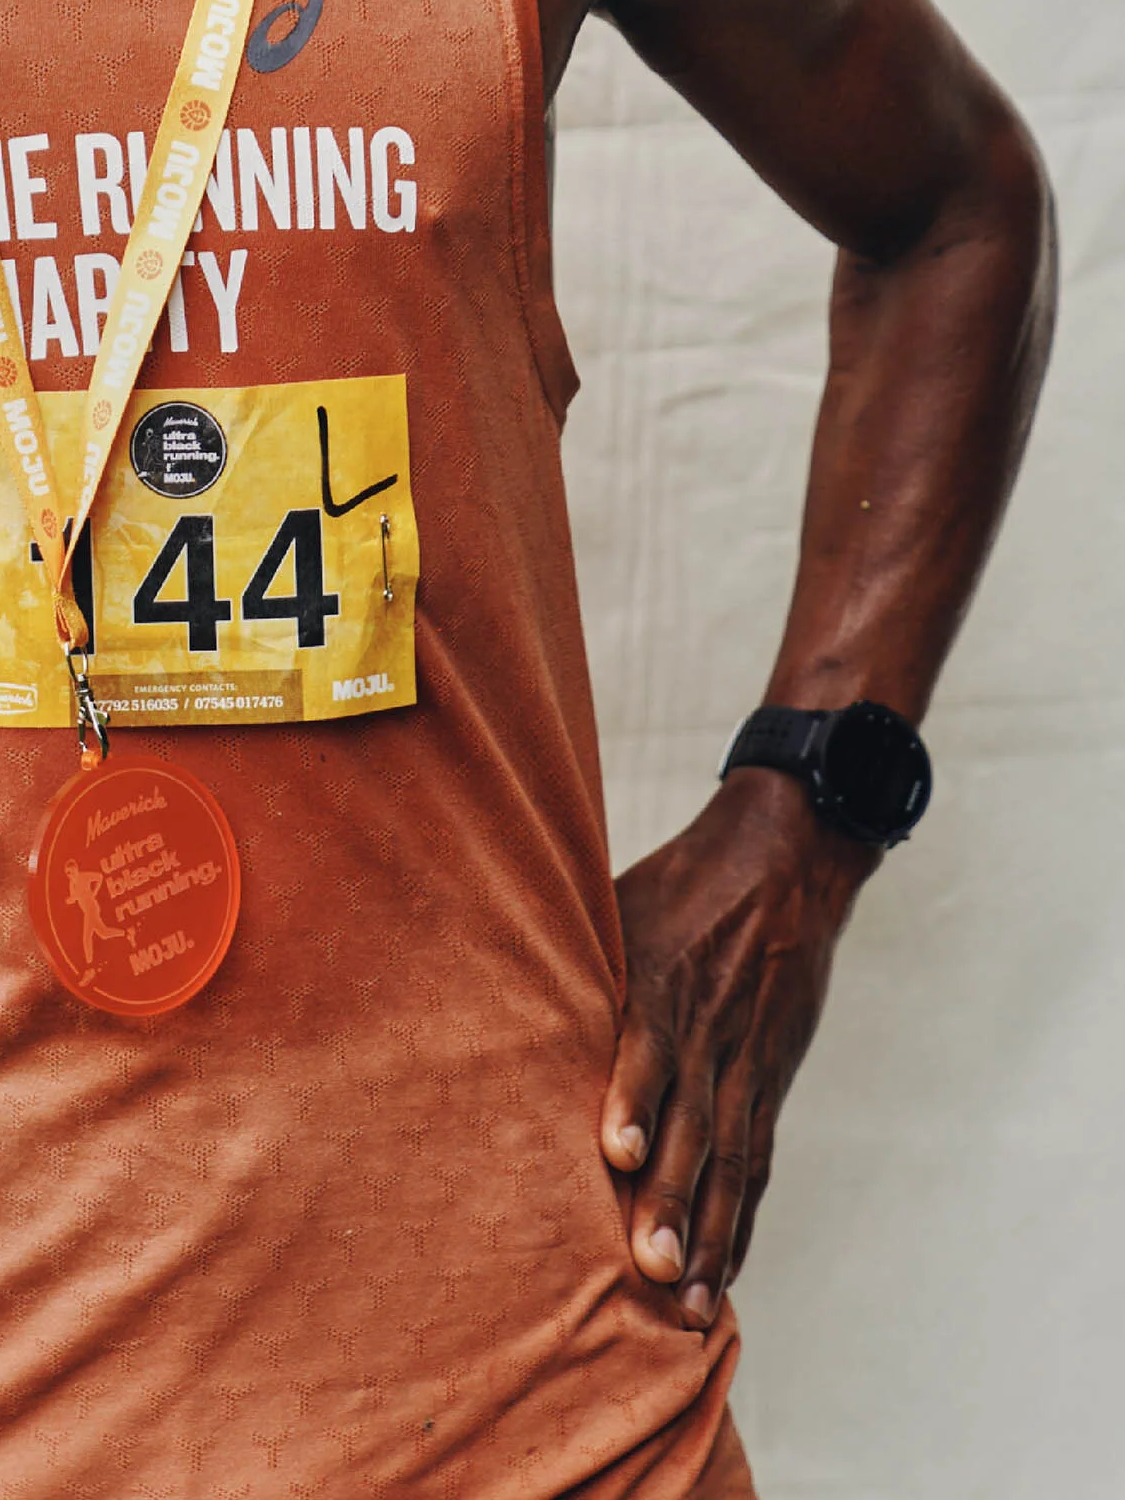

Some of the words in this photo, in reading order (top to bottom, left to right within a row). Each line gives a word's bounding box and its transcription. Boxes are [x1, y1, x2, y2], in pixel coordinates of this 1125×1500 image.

[148, 140, 200, 241] MOJU
[102, 291, 151, 388] MOJU
[2, 397, 50, 496] MOJU
[163, 430, 197, 441] ultra
[163, 440, 202, 451] black
[134, 684, 188, 694] EMERGENCY
[85, 785, 168, 848] Maverick
[100, 833, 165, 874] ultra
[106, 849, 182, 899] black
